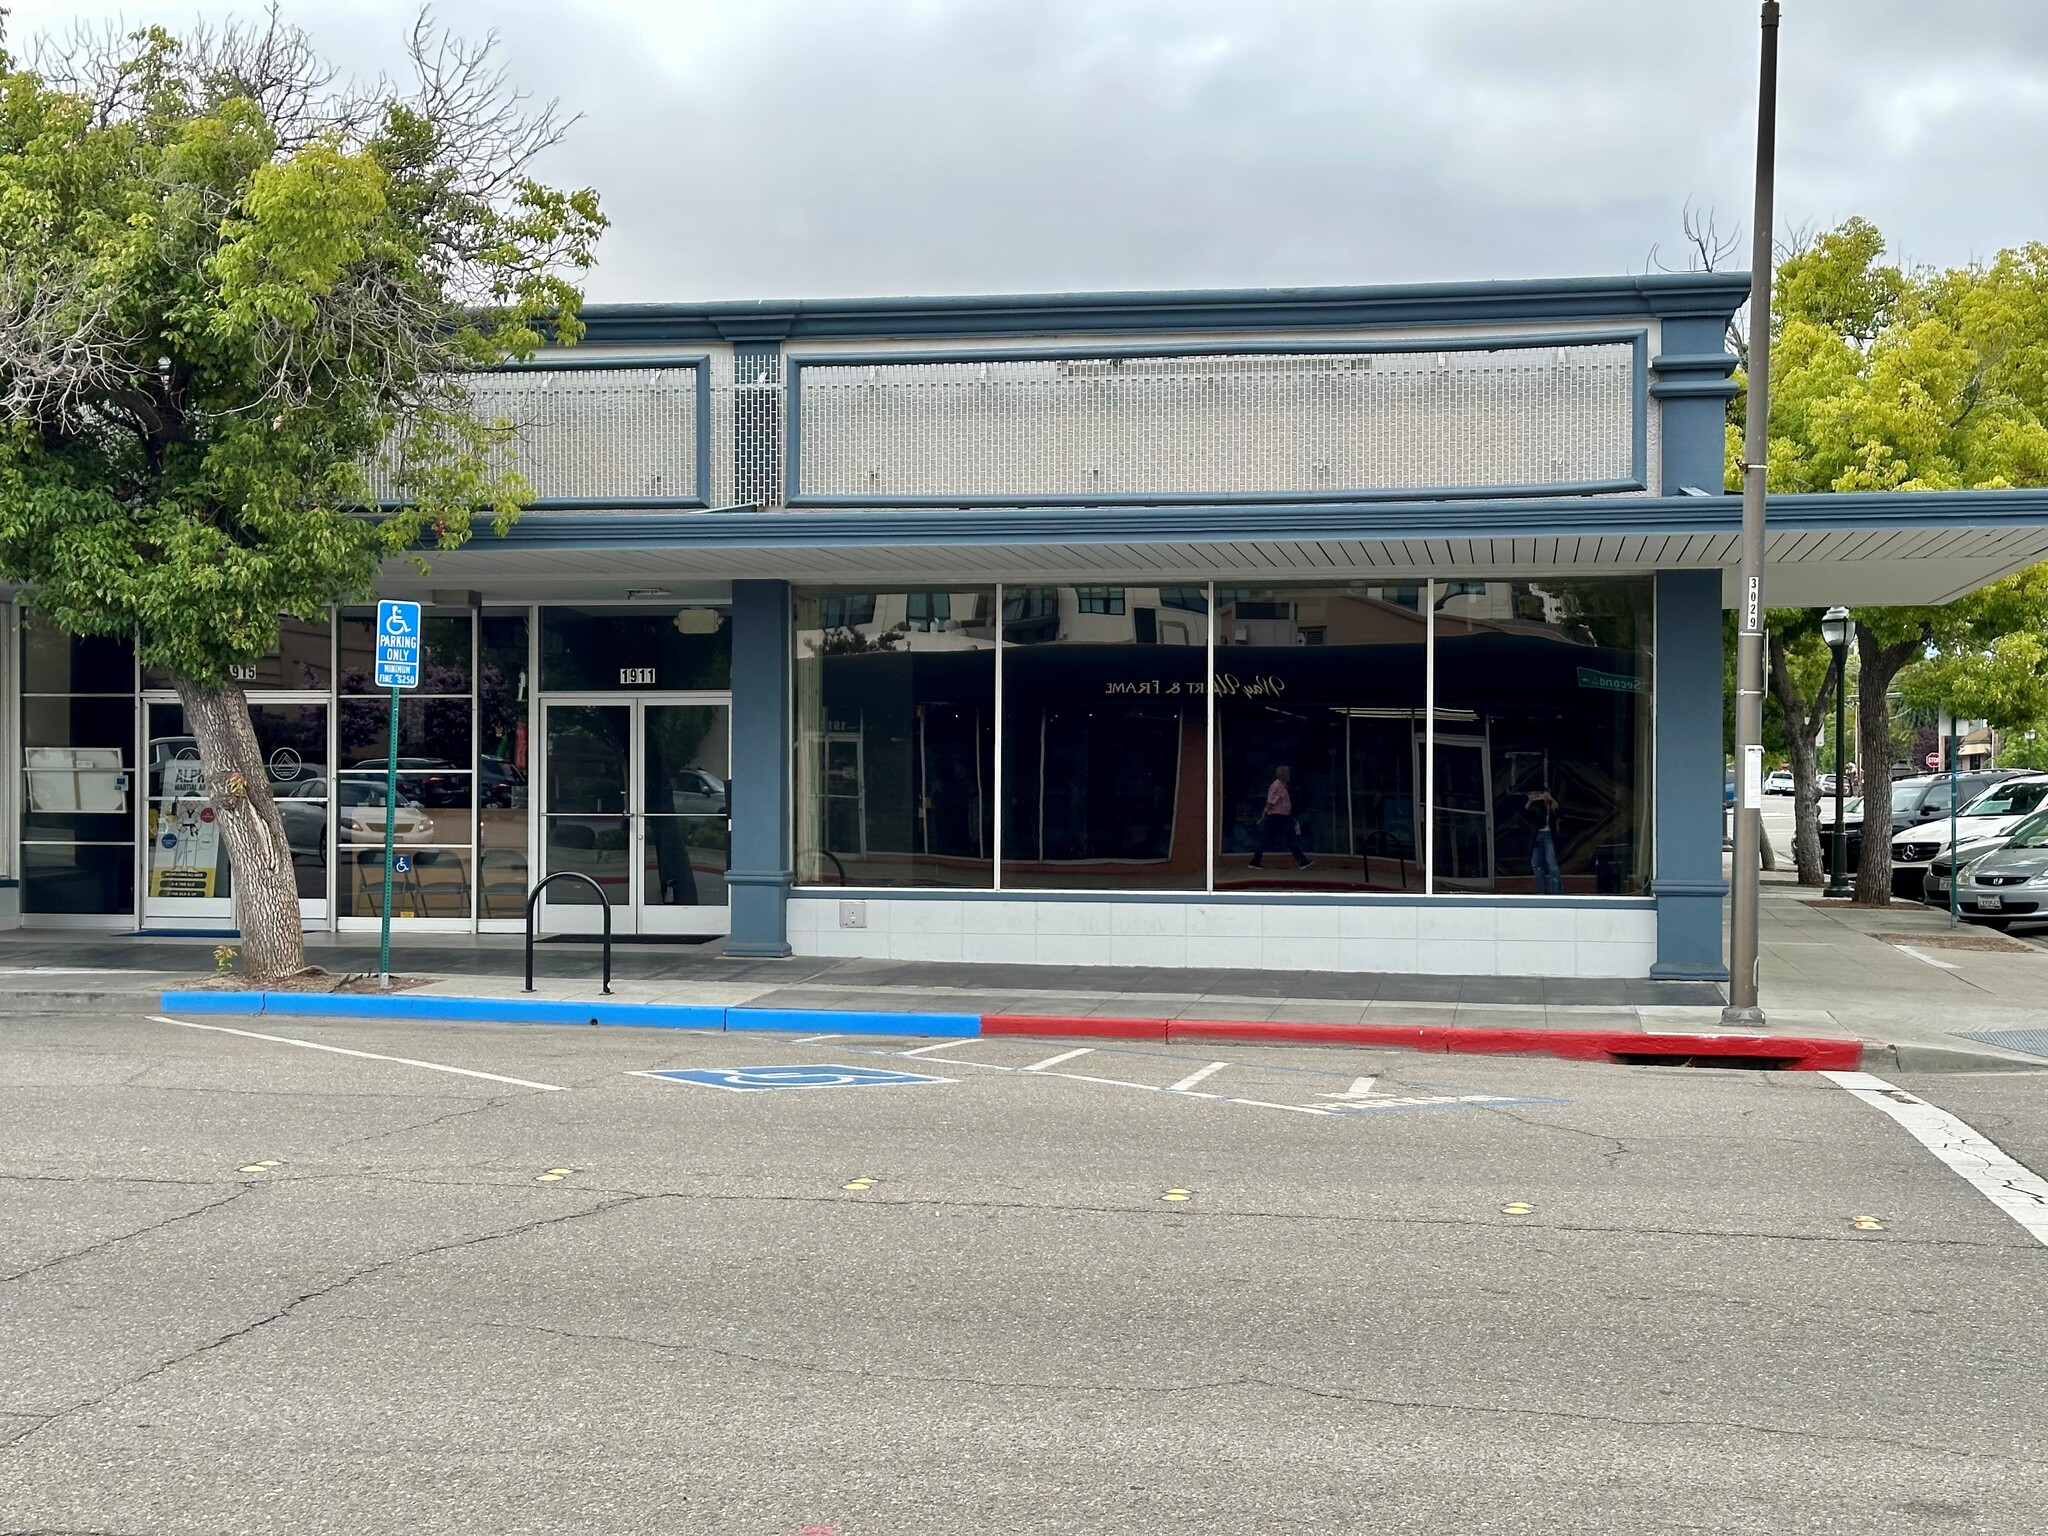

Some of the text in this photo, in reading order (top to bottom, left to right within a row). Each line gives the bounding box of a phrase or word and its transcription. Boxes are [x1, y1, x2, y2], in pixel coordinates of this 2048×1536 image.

[380, 635, 416, 649] PARKING
[387, 649, 409, 661] ONLY
[231, 665, 255, 679] 915
[385, 665, 410, 674] MINIMUM
[622, 669, 653, 682] 1911
[380, 674, 414, 684] FINE $250
[175, 768, 204, 783] ALPH
